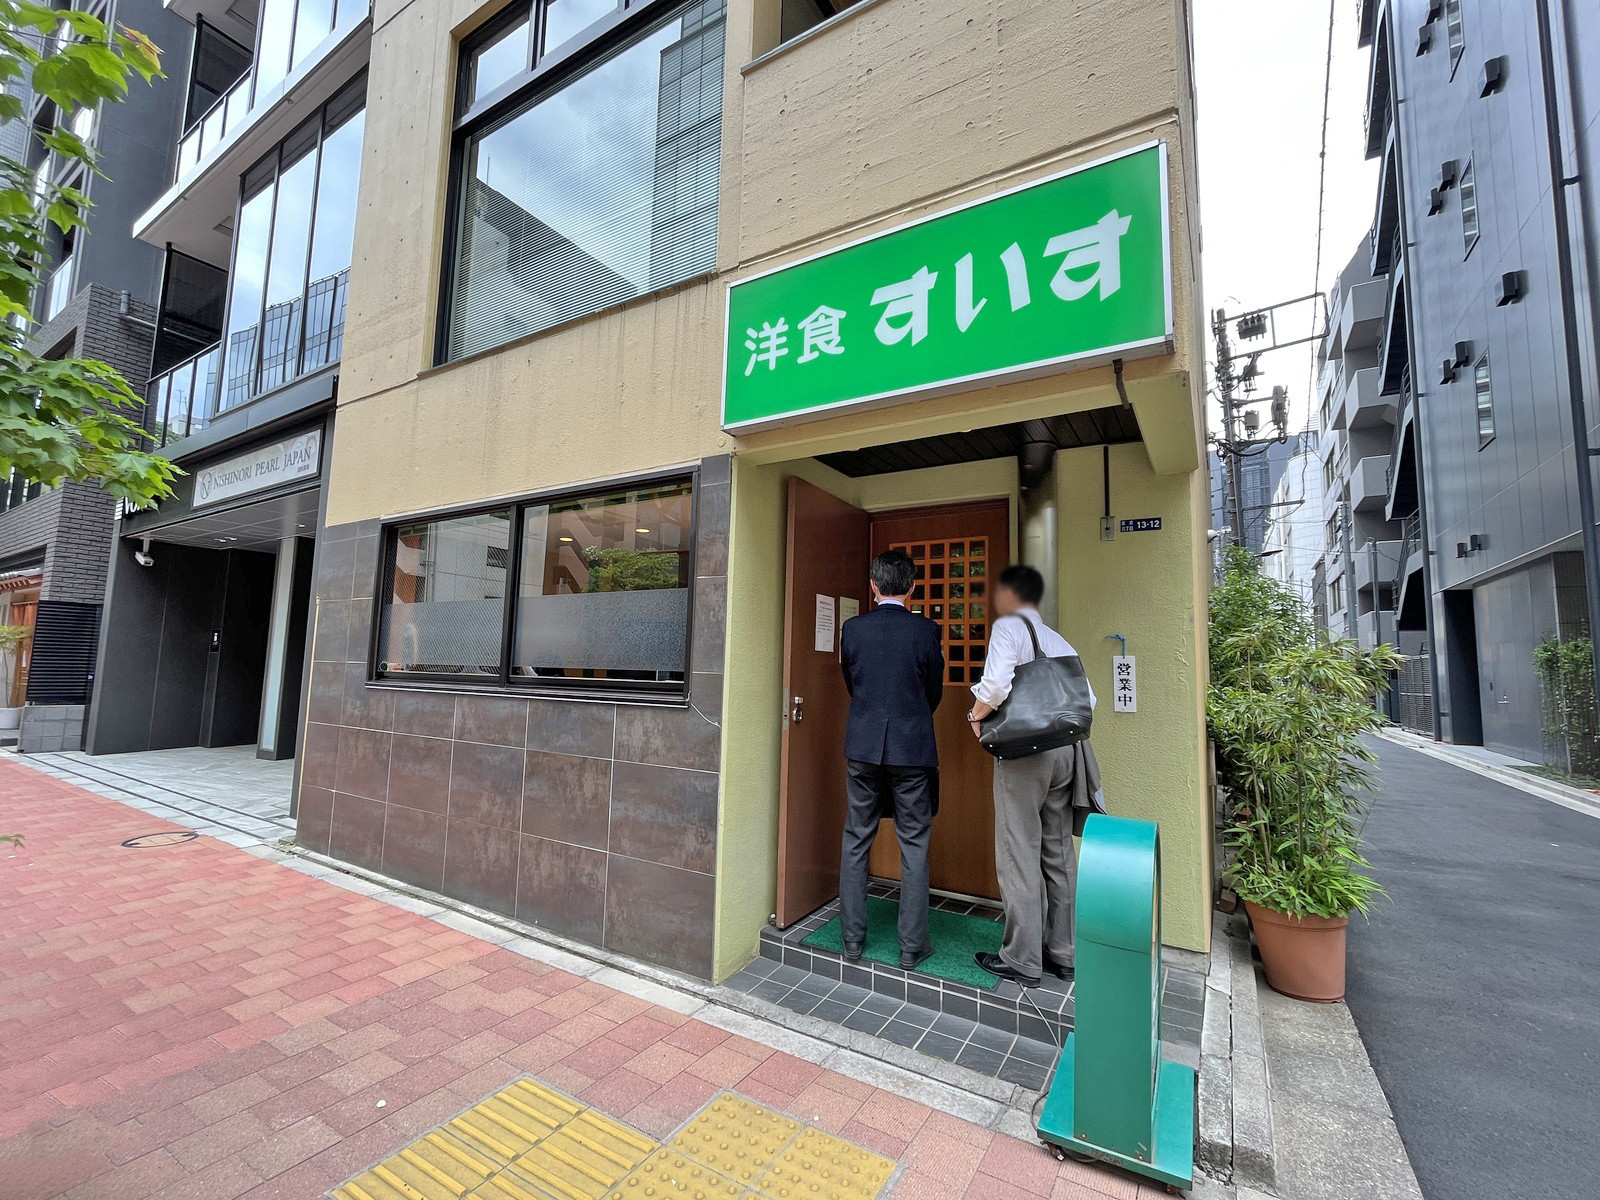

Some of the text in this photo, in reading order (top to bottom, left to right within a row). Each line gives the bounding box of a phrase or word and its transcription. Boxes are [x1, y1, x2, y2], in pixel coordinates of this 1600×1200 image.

[744, 208, 1133, 377] 洋食 すいす
[213, 465, 252, 489] NISHINORI
[255, 457, 280, 477] PEARL
[282, 446, 312, 472] JAPAN
[1136, 519, 1160, 529] 13-12
[1117, 662, 1132, 707] 営業中
